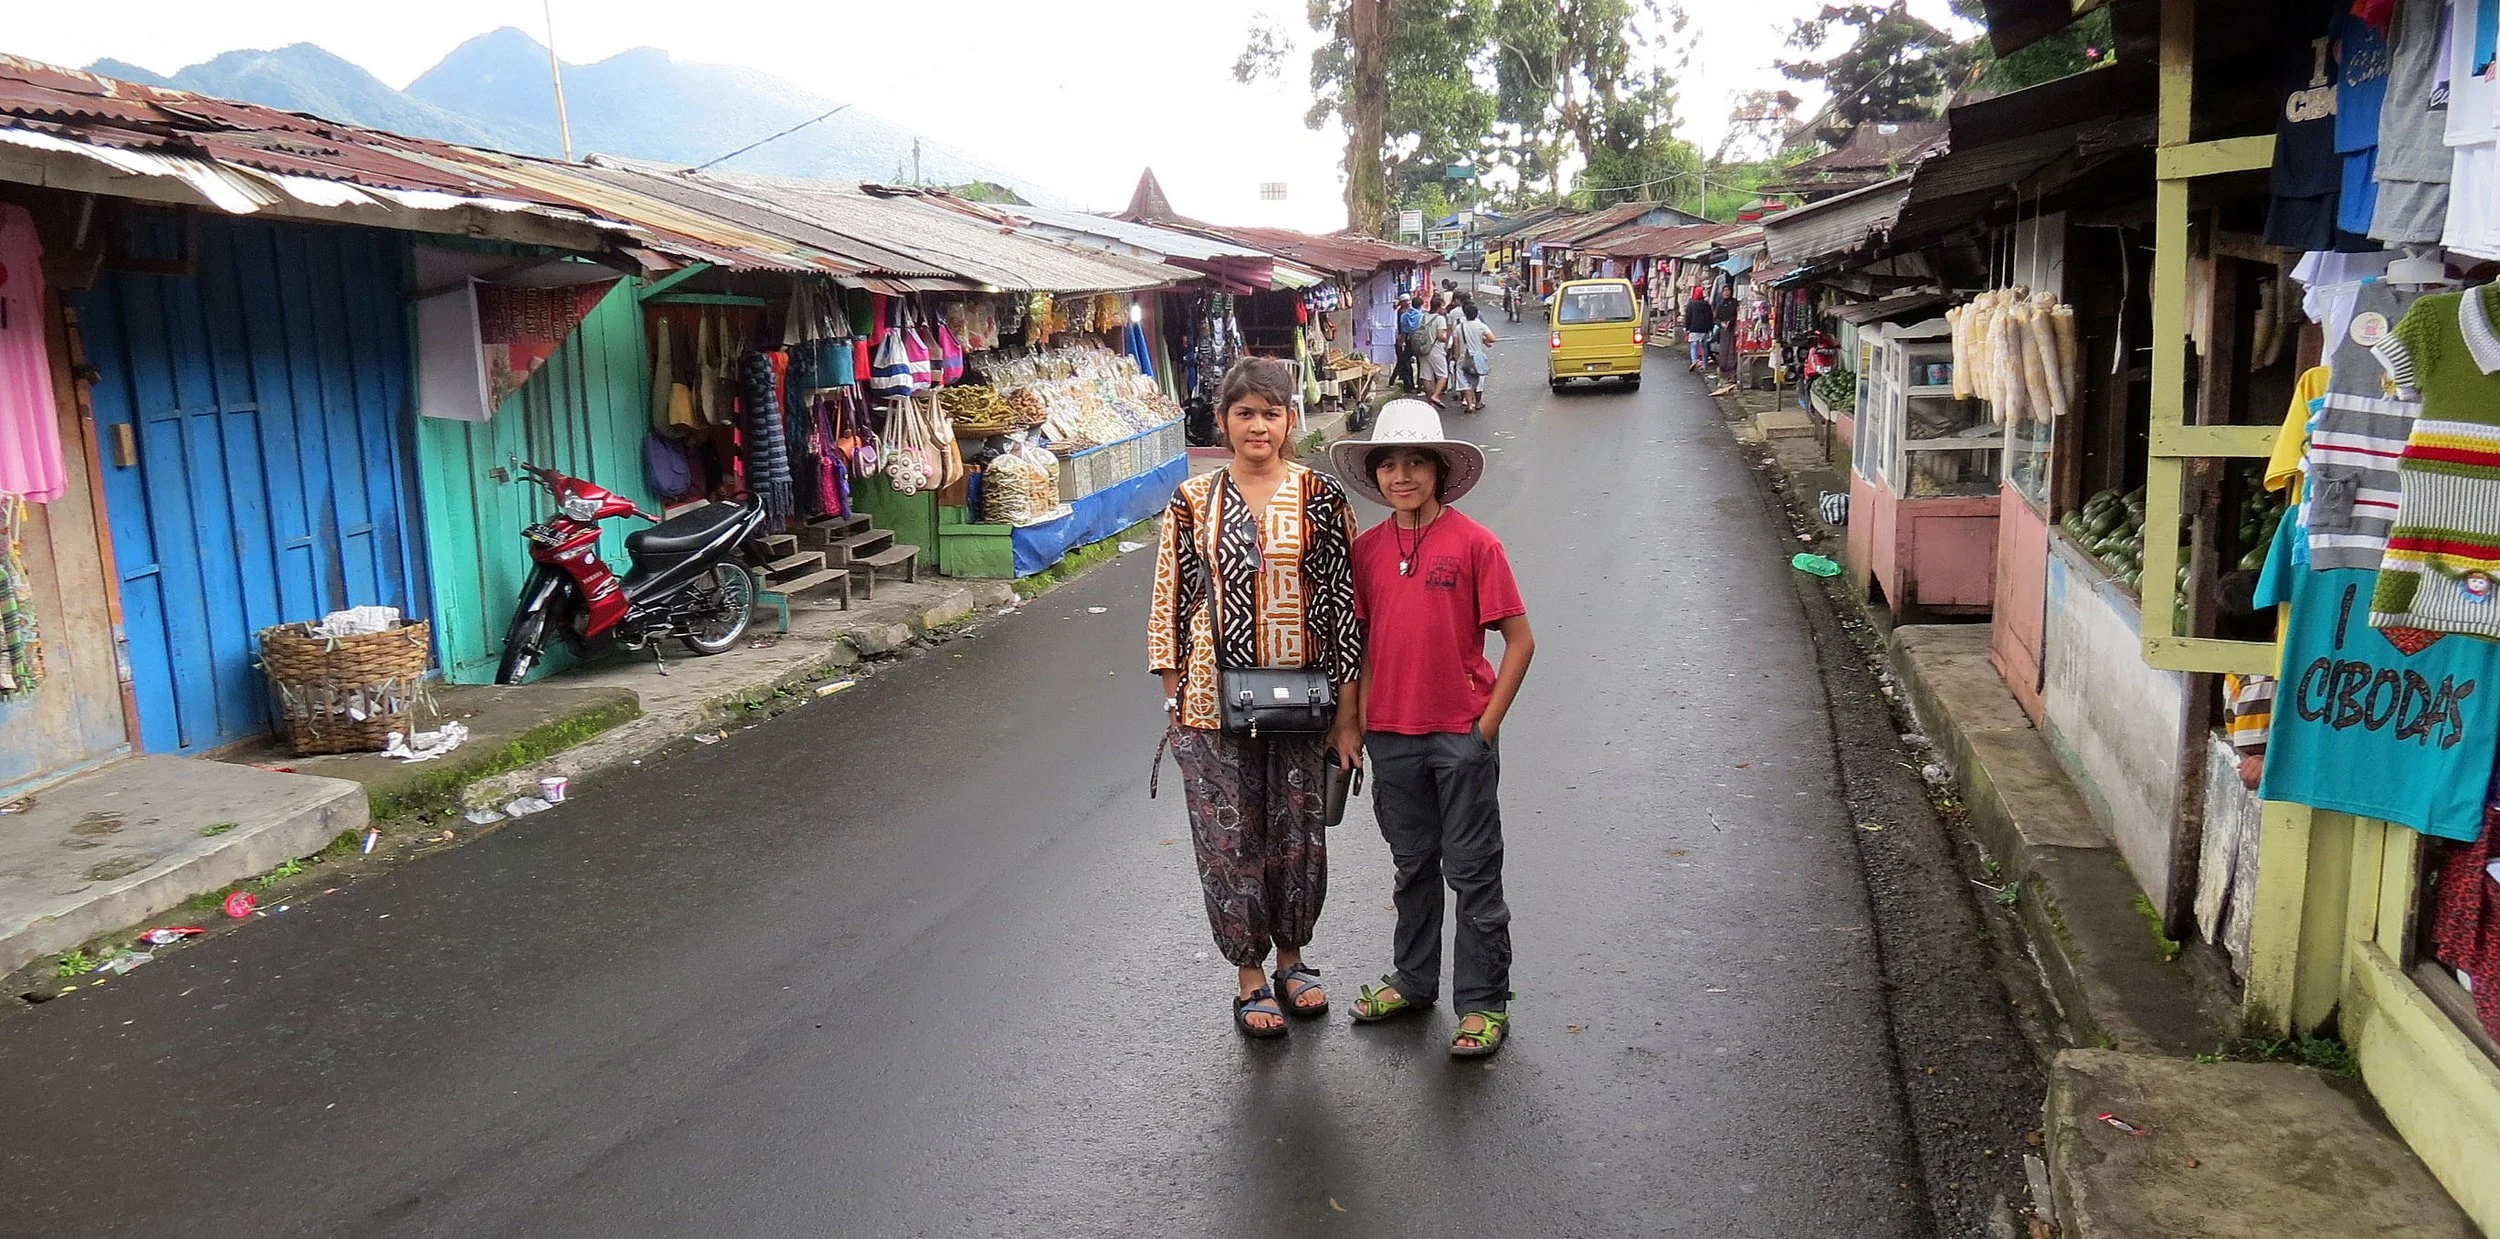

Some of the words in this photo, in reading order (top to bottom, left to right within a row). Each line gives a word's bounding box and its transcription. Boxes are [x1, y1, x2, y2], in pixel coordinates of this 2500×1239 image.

[2309, 36, 2330, 88] I
[2335, 583, 2356, 650] I
[2297, 656, 2475, 750] CIBODAS
